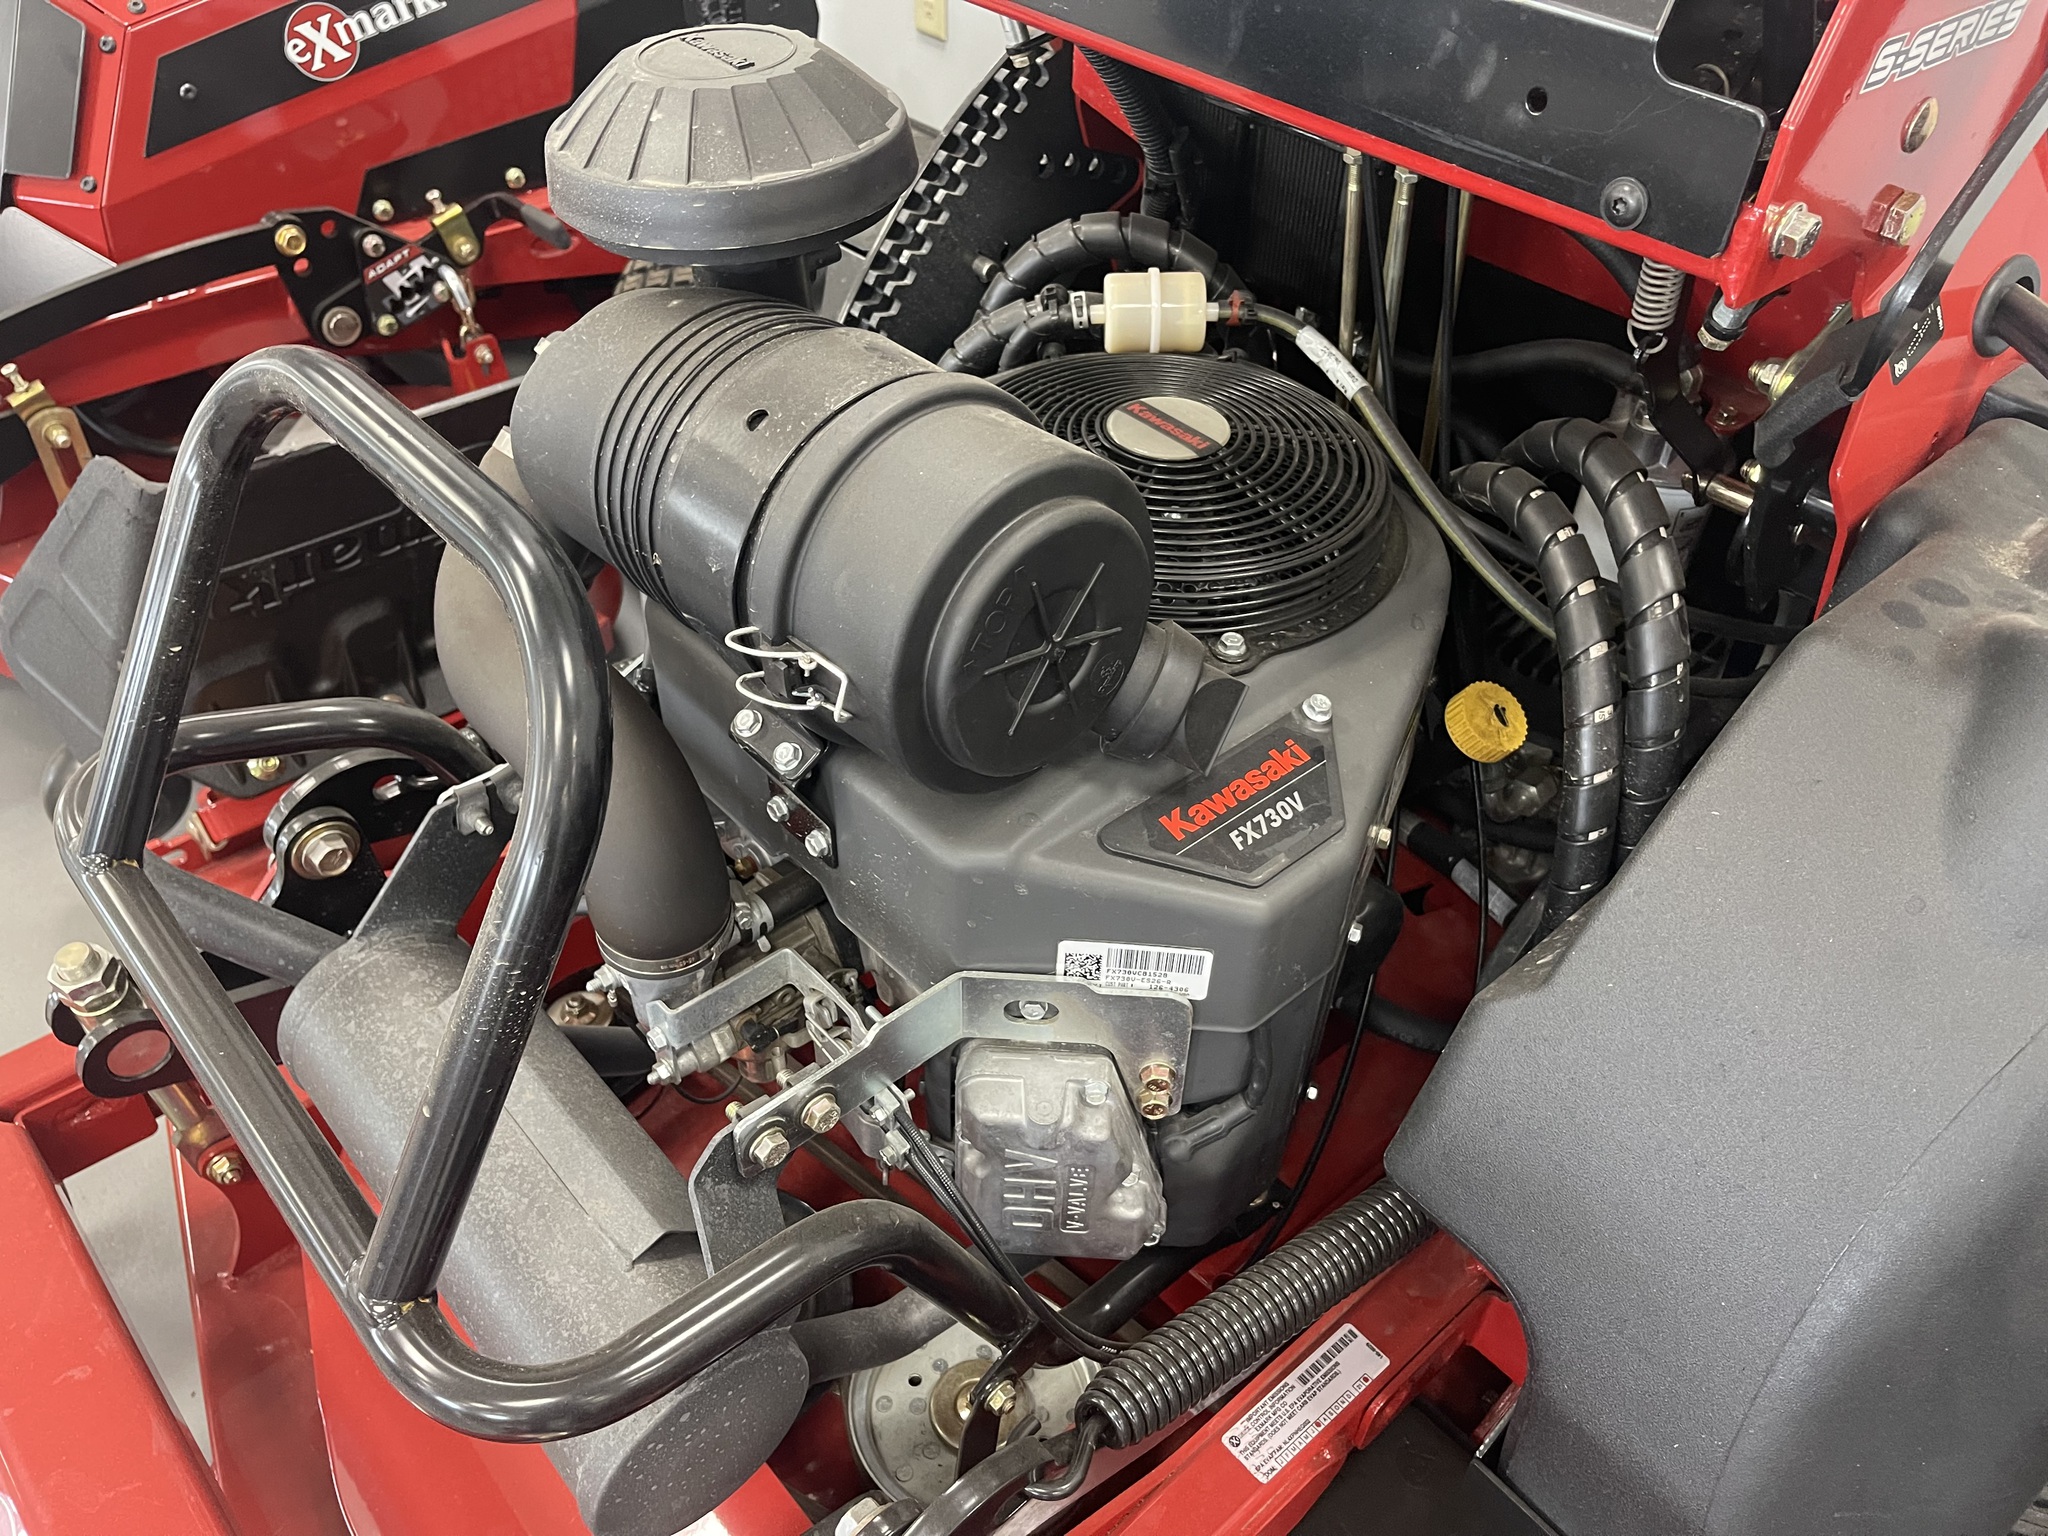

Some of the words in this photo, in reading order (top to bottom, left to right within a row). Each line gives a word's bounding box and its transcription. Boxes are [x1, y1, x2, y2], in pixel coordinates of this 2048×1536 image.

[680, 34, 755, 70] Kawasaki
[1863, 0, 2028, 90] S-SERIES
[368, 248, 411, 280] ADAPT
[1126, 402, 1212, 450] Kawasaki
[1159, 738, 1311, 841] Kawasaki
[1229, 790, 1305, 851] FX730V
[1238, 1445, 1249, 1455] THIS
[1247, 1425, 1271, 1447] EQUIPMENT
[1268, 1413, 1284, 1428] MEETS
[1288, 1399, 1298, 1410] EPA
[1295, 1377, 1322, 1403] EVAPORATIVE
[1320, 1360, 1341, 1381] EMISSIONS
[1244, 1399, 1269, 1422] IMPORTANT
[1249, 1406, 1270, 1426] CONTROL
[1267, 1383, 1296, 1410] INFORMATION
[1253, 1413, 1273, 1432] EXMARK
[1270, 1405, 1281, 1416] MFG
[1278, 1399, 1288, 1408] CO
[1278, 1417, 1289, 1428] NOT
[1286, 1408, 1299, 1421] MEET
[1296, 1398, 1309, 1411] CARB
[1306, 1389, 1319, 1402] EVAP
